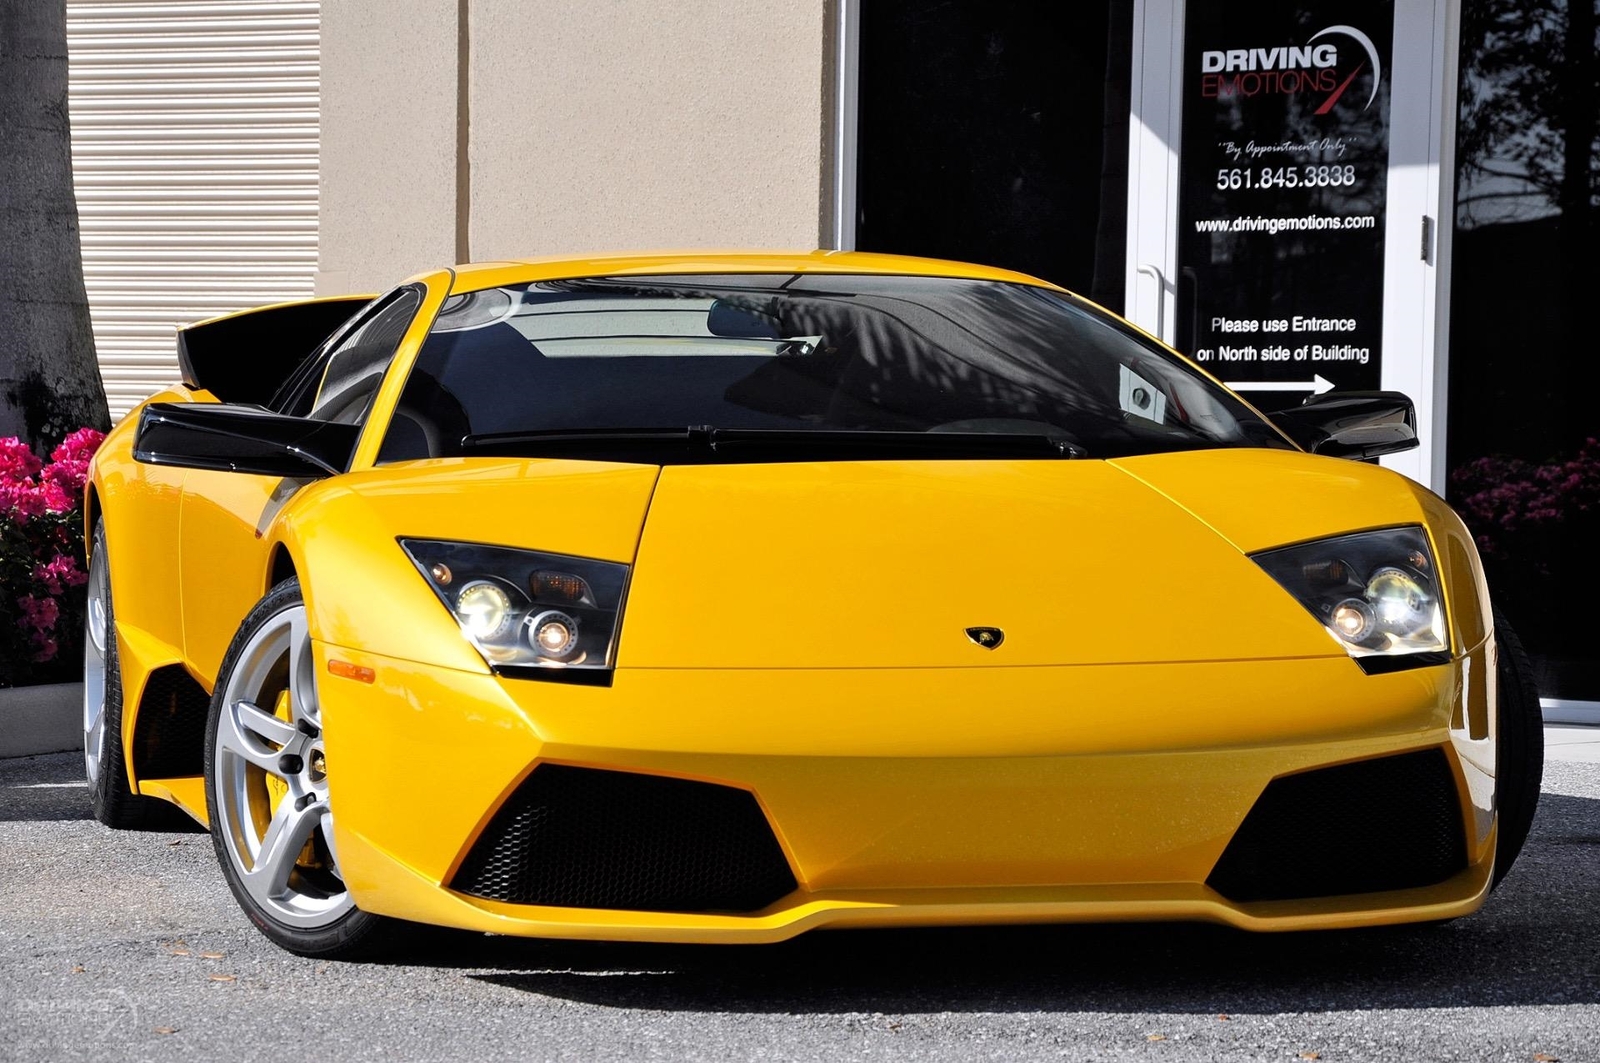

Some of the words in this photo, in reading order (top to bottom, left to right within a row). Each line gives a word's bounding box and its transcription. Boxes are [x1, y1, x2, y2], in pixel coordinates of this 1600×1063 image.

[1202, 44, 1338, 73] DRIVING
[1202, 69, 1337, 97] EMOTIONS
[1245, 140, 1318, 158] Appointment
[1216, 165, 1356, 190] 561.845.3838
[1195, 214, 1375, 235] www.drivingemotions.com
[1211, 317, 1259, 333] Please
[1262, 319, 1288, 332] use
[1292, 316, 1356, 332] Entrance
[1197, 349, 1214, 361] on
[1219, 346, 1257, 361] North
[1261, 345, 1290, 361] side
[1294, 346, 1309, 361] of
[1311, 344, 1370, 364] Building
